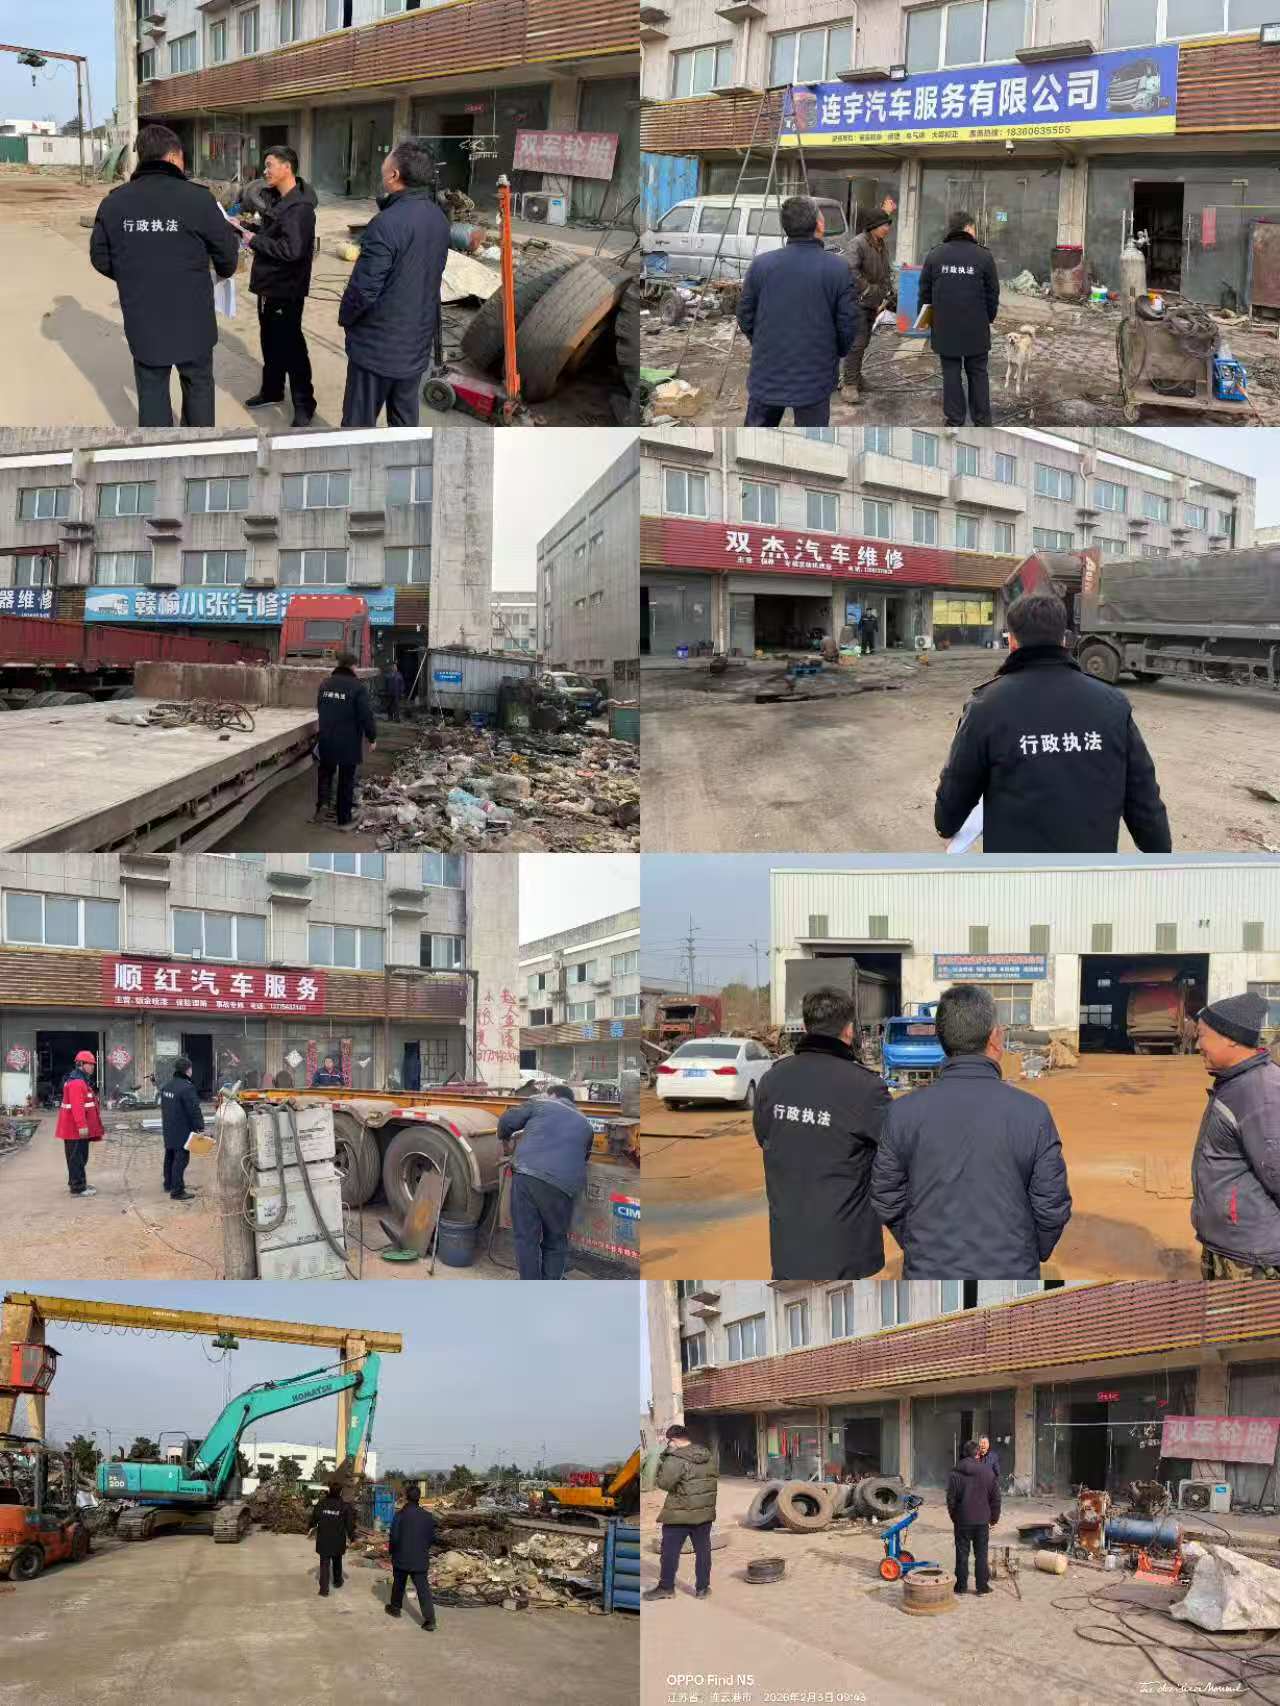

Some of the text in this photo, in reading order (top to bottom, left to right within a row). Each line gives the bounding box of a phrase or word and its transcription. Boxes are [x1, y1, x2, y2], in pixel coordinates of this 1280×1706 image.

[821, 70, 1099, 125] 连宇汽车服务有限公司
[122, 218, 179, 233] 行政执法
[725, 530, 905, 571] 双杰汽车维修
[0, 589, 53, 610] 器维修
[1019, 730, 1102, 755] 行政执法
[113, 963, 319, 1001] 顺红汽车服务
[772, 1103, 832, 1127] 行政执法
